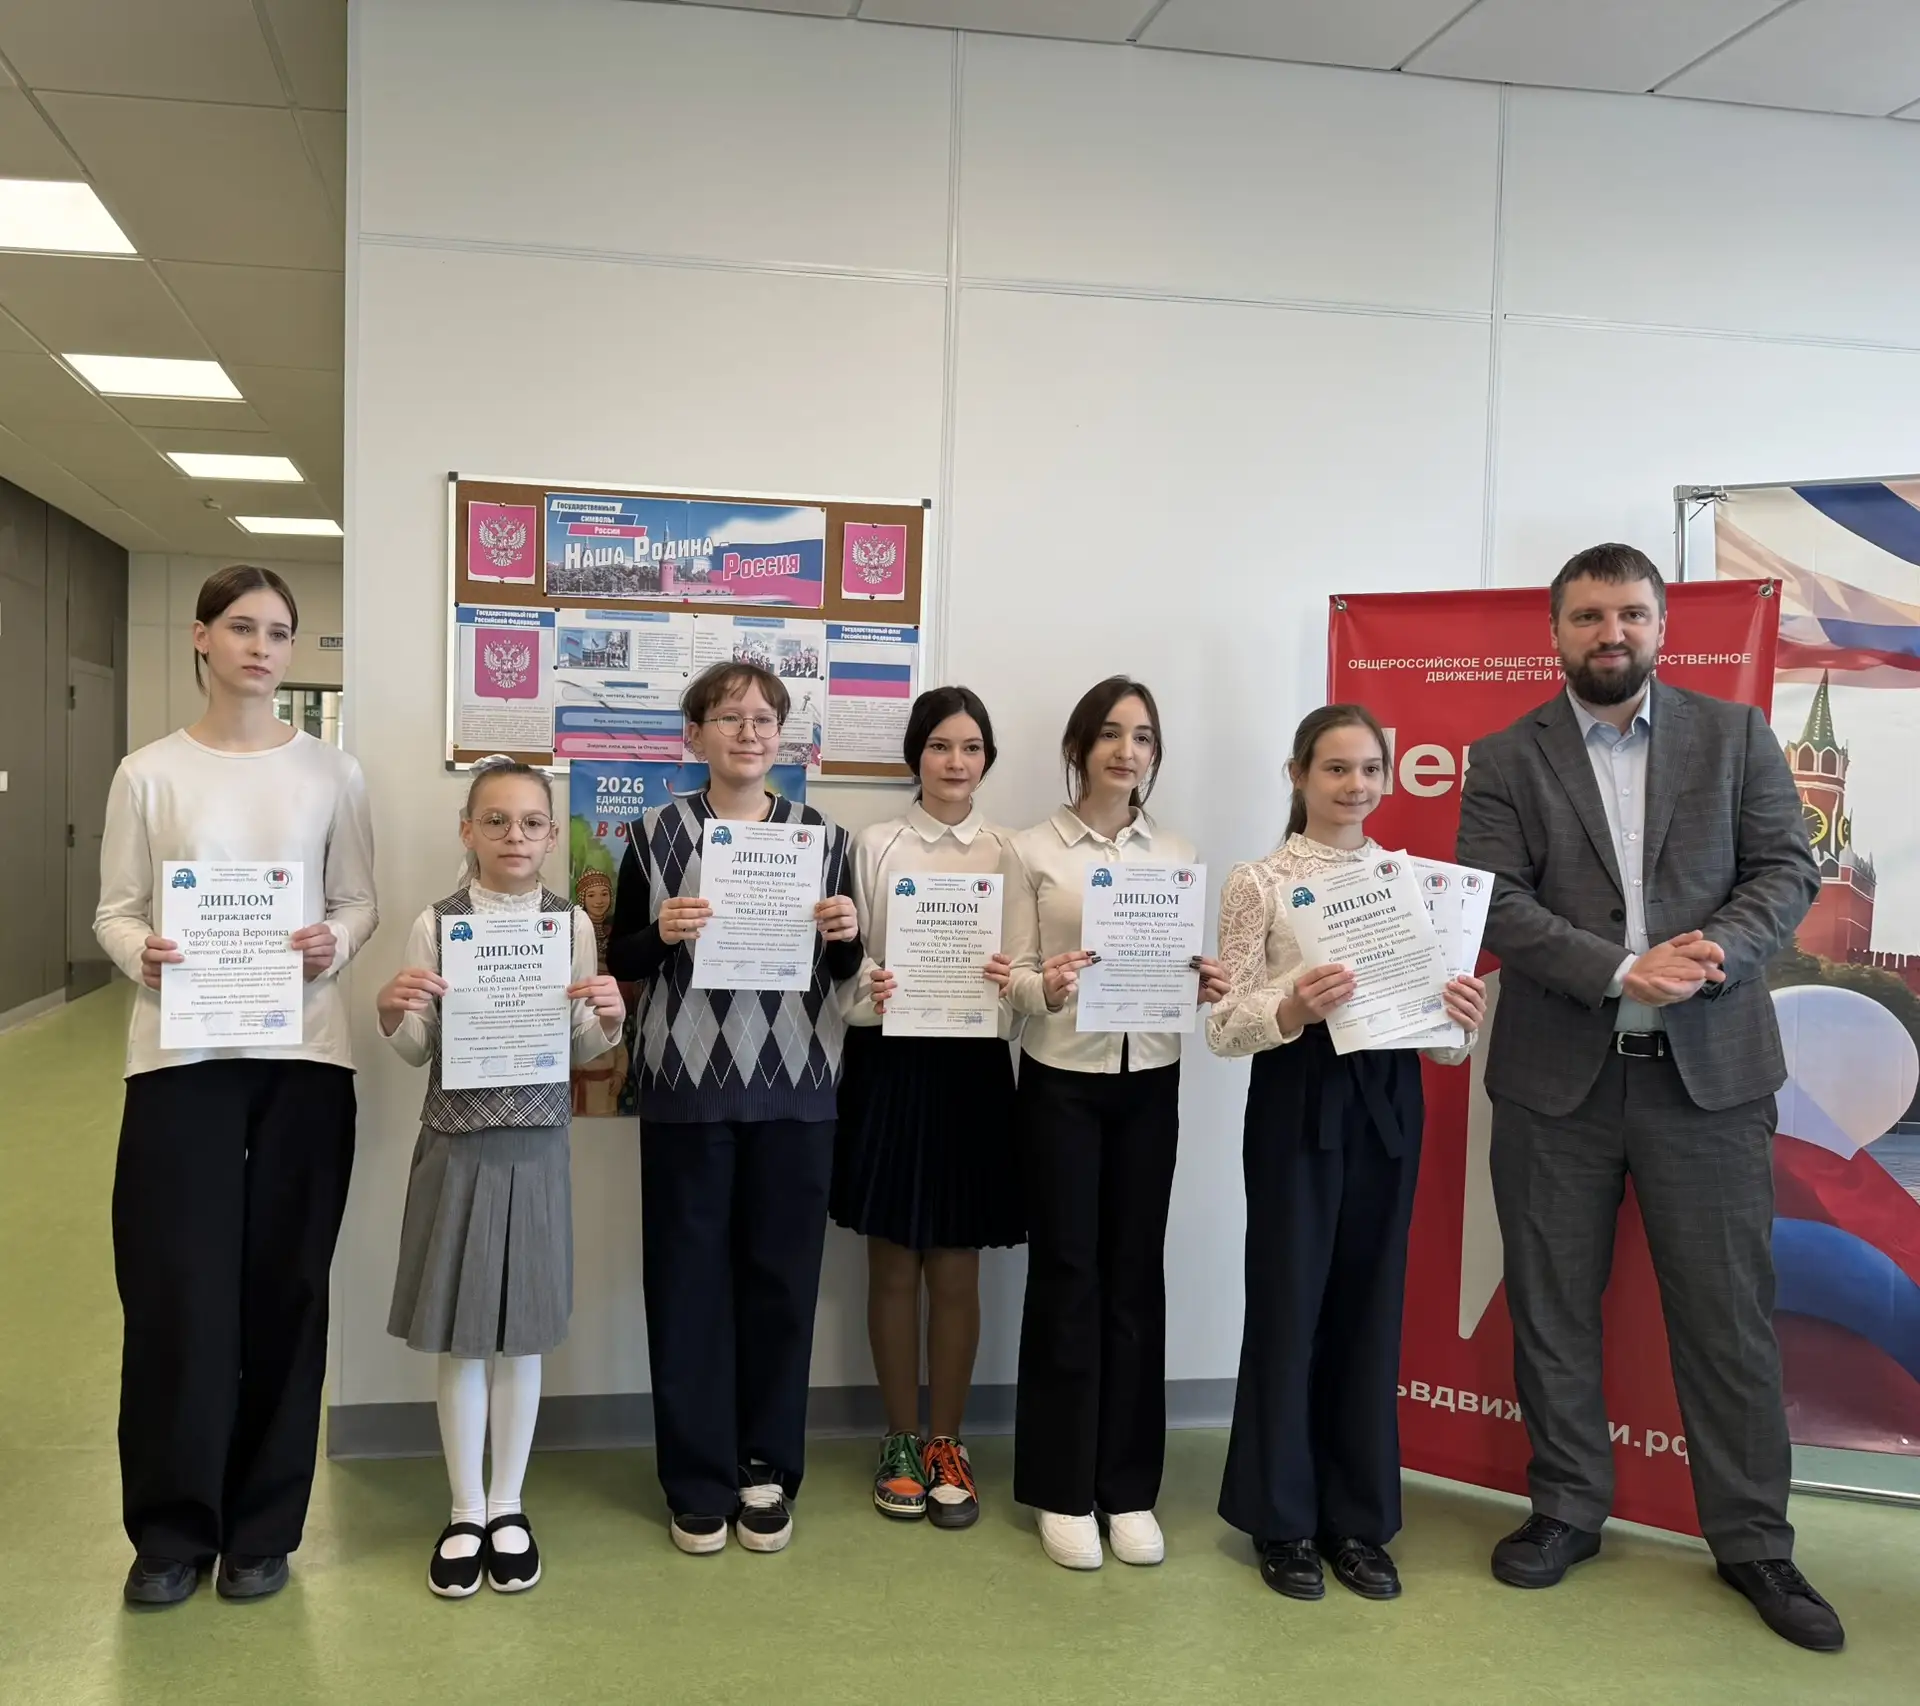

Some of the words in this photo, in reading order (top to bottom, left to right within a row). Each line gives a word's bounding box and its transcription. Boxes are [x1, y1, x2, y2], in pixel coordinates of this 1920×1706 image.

[557, 502, 615, 511] Государственные
[581, 515, 614, 523] символы
[594, 527, 620, 535] России
[1348, 656, 1480, 670] ОБЩЕРОССИЙСКОЕ
[1484, 656, 1563, 669] ОБЩЕСТВЕ
[1655, 653, 1752, 666] РСТВЕННОЕ
[1426, 671, 1503, 683] ДВИЖЕНИЕ
[1506, 670, 1553, 682] ДЕТЕЙ
[597, 777, 644, 793] 2026
[596, 796, 643, 805] ЕДИНСТВО
[596, 805, 639, 815] НАРОДОВ
[732, 852, 798, 864] ДИПЛОМ
[732, 869, 796, 878] награждаются
[198, 895, 273, 908] ДИПЛОМ
[1113, 893, 1179, 906] ДИПЛОМ
[1322, 888, 1392, 919] ДИПЛОМ
[736, 908, 787, 916] ПОБЕДИТЕЛИ
[916, 902, 978, 913] ДИПЛОМ
[201, 913, 271, 922] награждается
[1114, 911, 1178, 919] награждаются
[1328, 905, 1396, 930] награждаются
[916, 919, 977, 927] награждаются
[182, 929, 239, 939] Торубарова
[243, 928, 289, 936] Вероника
[474, 944, 543, 959] ДИПЛОМ
[1356, 948, 1395, 965] ПРИЗЁРЫ
[478, 962, 542, 972] награждается
[479, 975, 515, 984] Кобцева
[519, 974, 541, 982] Анна
